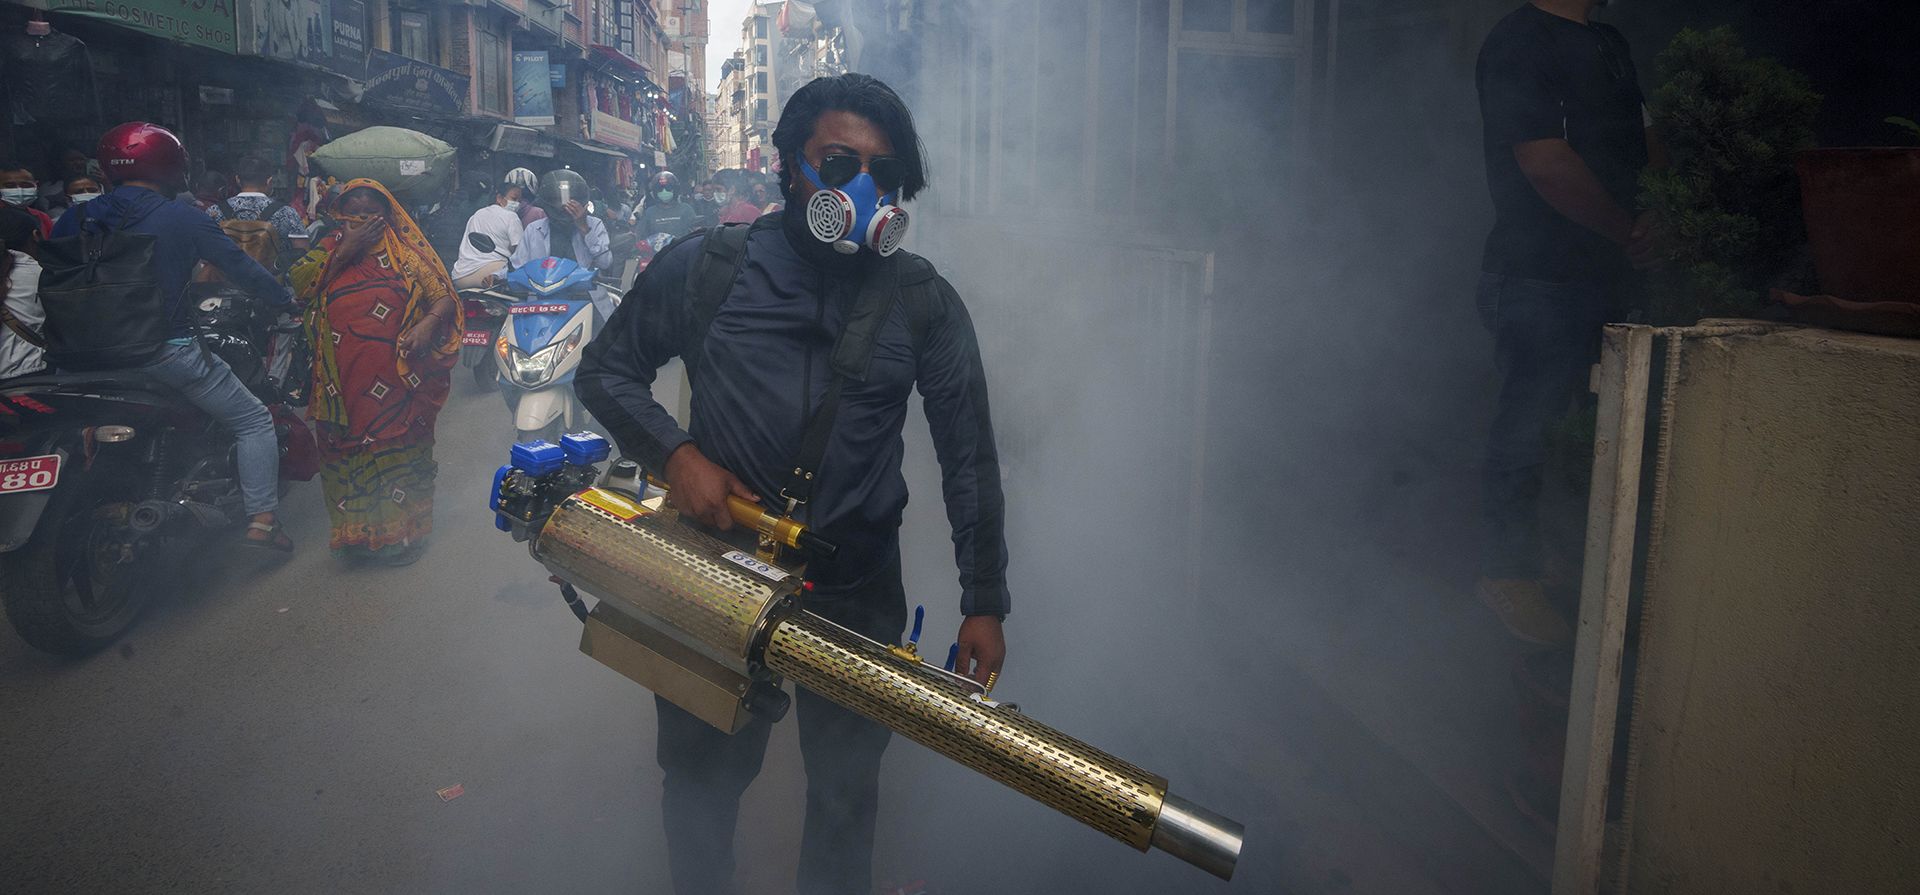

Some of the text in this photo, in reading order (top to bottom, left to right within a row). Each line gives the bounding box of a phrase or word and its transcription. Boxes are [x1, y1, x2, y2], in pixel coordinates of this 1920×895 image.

[105, 1, 189, 35] COSMETIC
[196, 24, 231, 45] SHOP
[333, 19, 362, 42] PURNA
